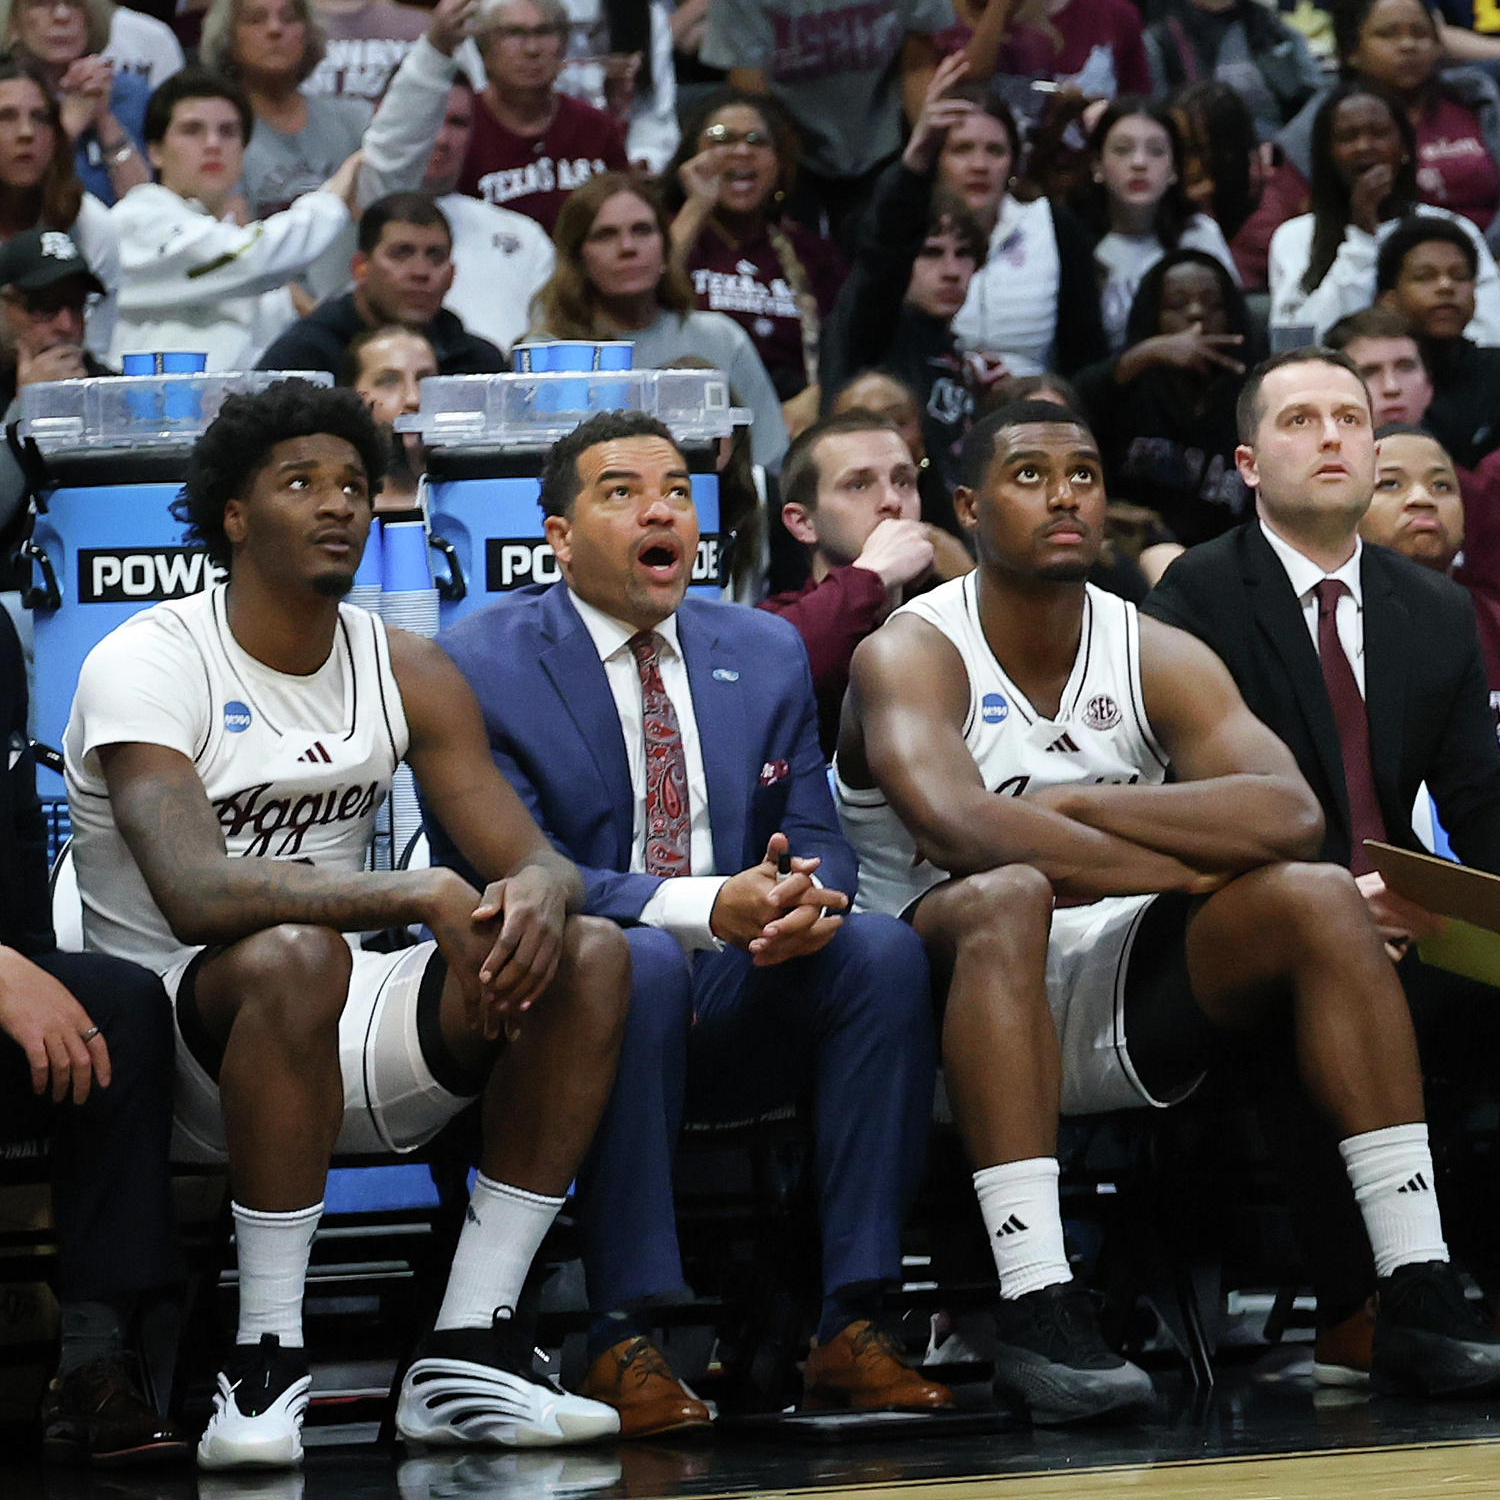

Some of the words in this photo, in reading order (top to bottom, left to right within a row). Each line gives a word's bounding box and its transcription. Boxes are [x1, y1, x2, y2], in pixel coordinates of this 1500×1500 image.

[501, 541, 719, 586] PODE
[223, 712, 252, 728] NCAA
[1090, 695, 1117, 720] SEC
[212, 781, 379, 858] Aggies
